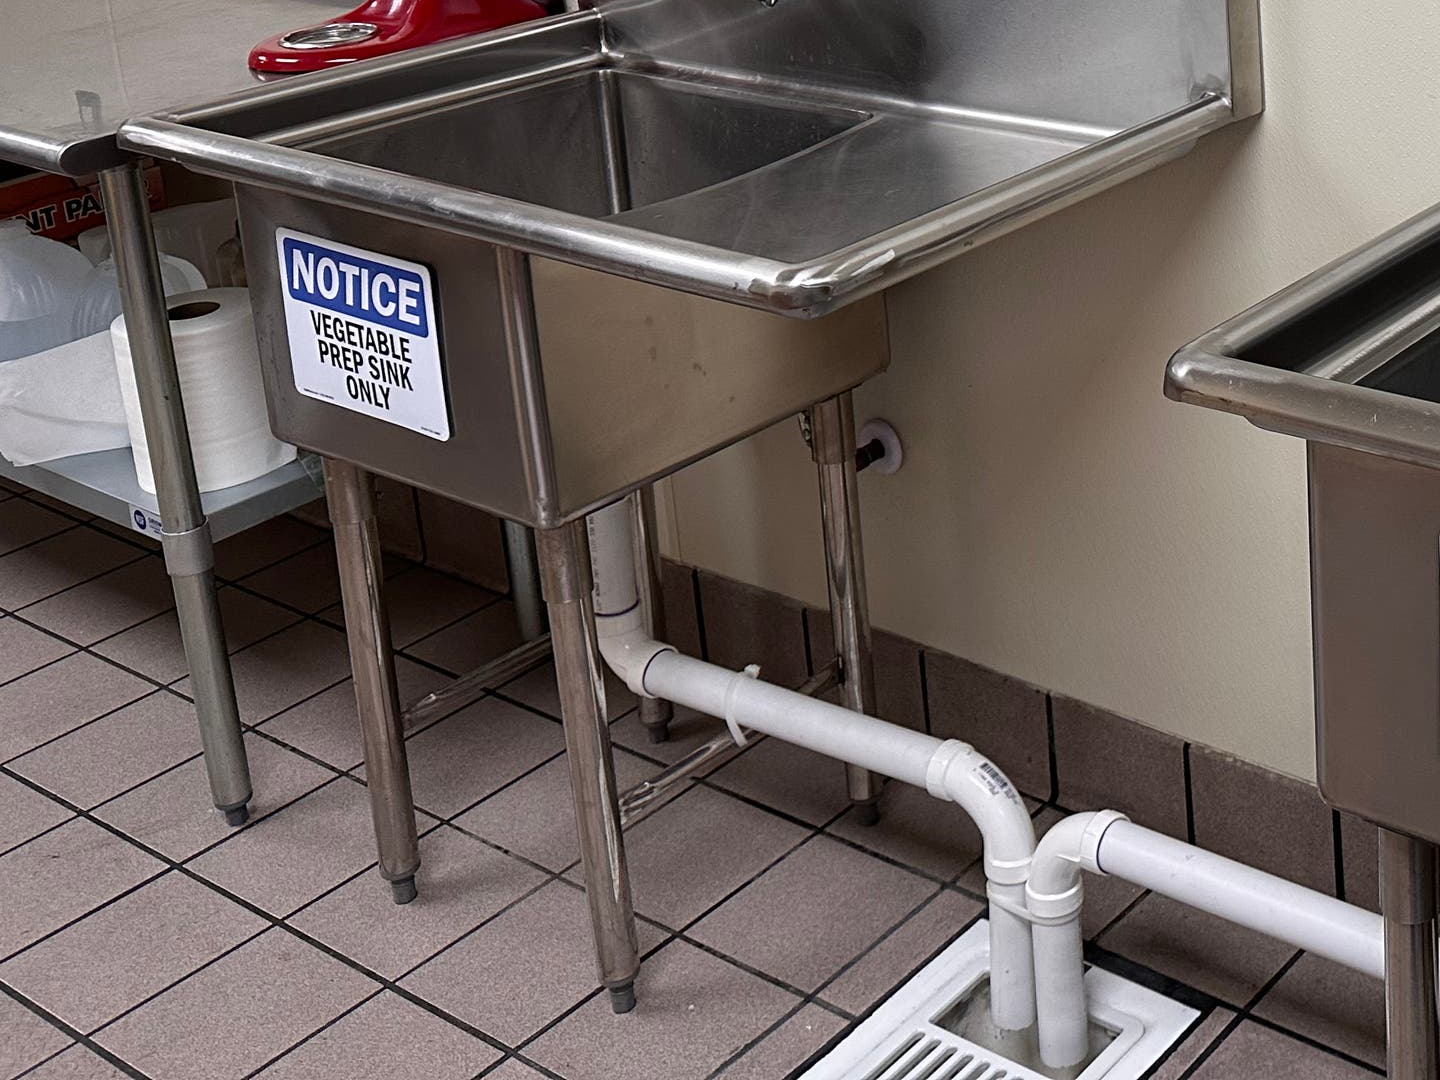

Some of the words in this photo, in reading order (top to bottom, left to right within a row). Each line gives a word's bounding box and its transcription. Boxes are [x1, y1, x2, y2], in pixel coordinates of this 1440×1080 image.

[292, 248, 421, 326] NOTICE
[310, 309, 412, 364] VEGETABLE
[317, 338, 364, 374] PREP
[368, 355, 414, 392] SINK
[346, 375, 390, 410] ONLY
